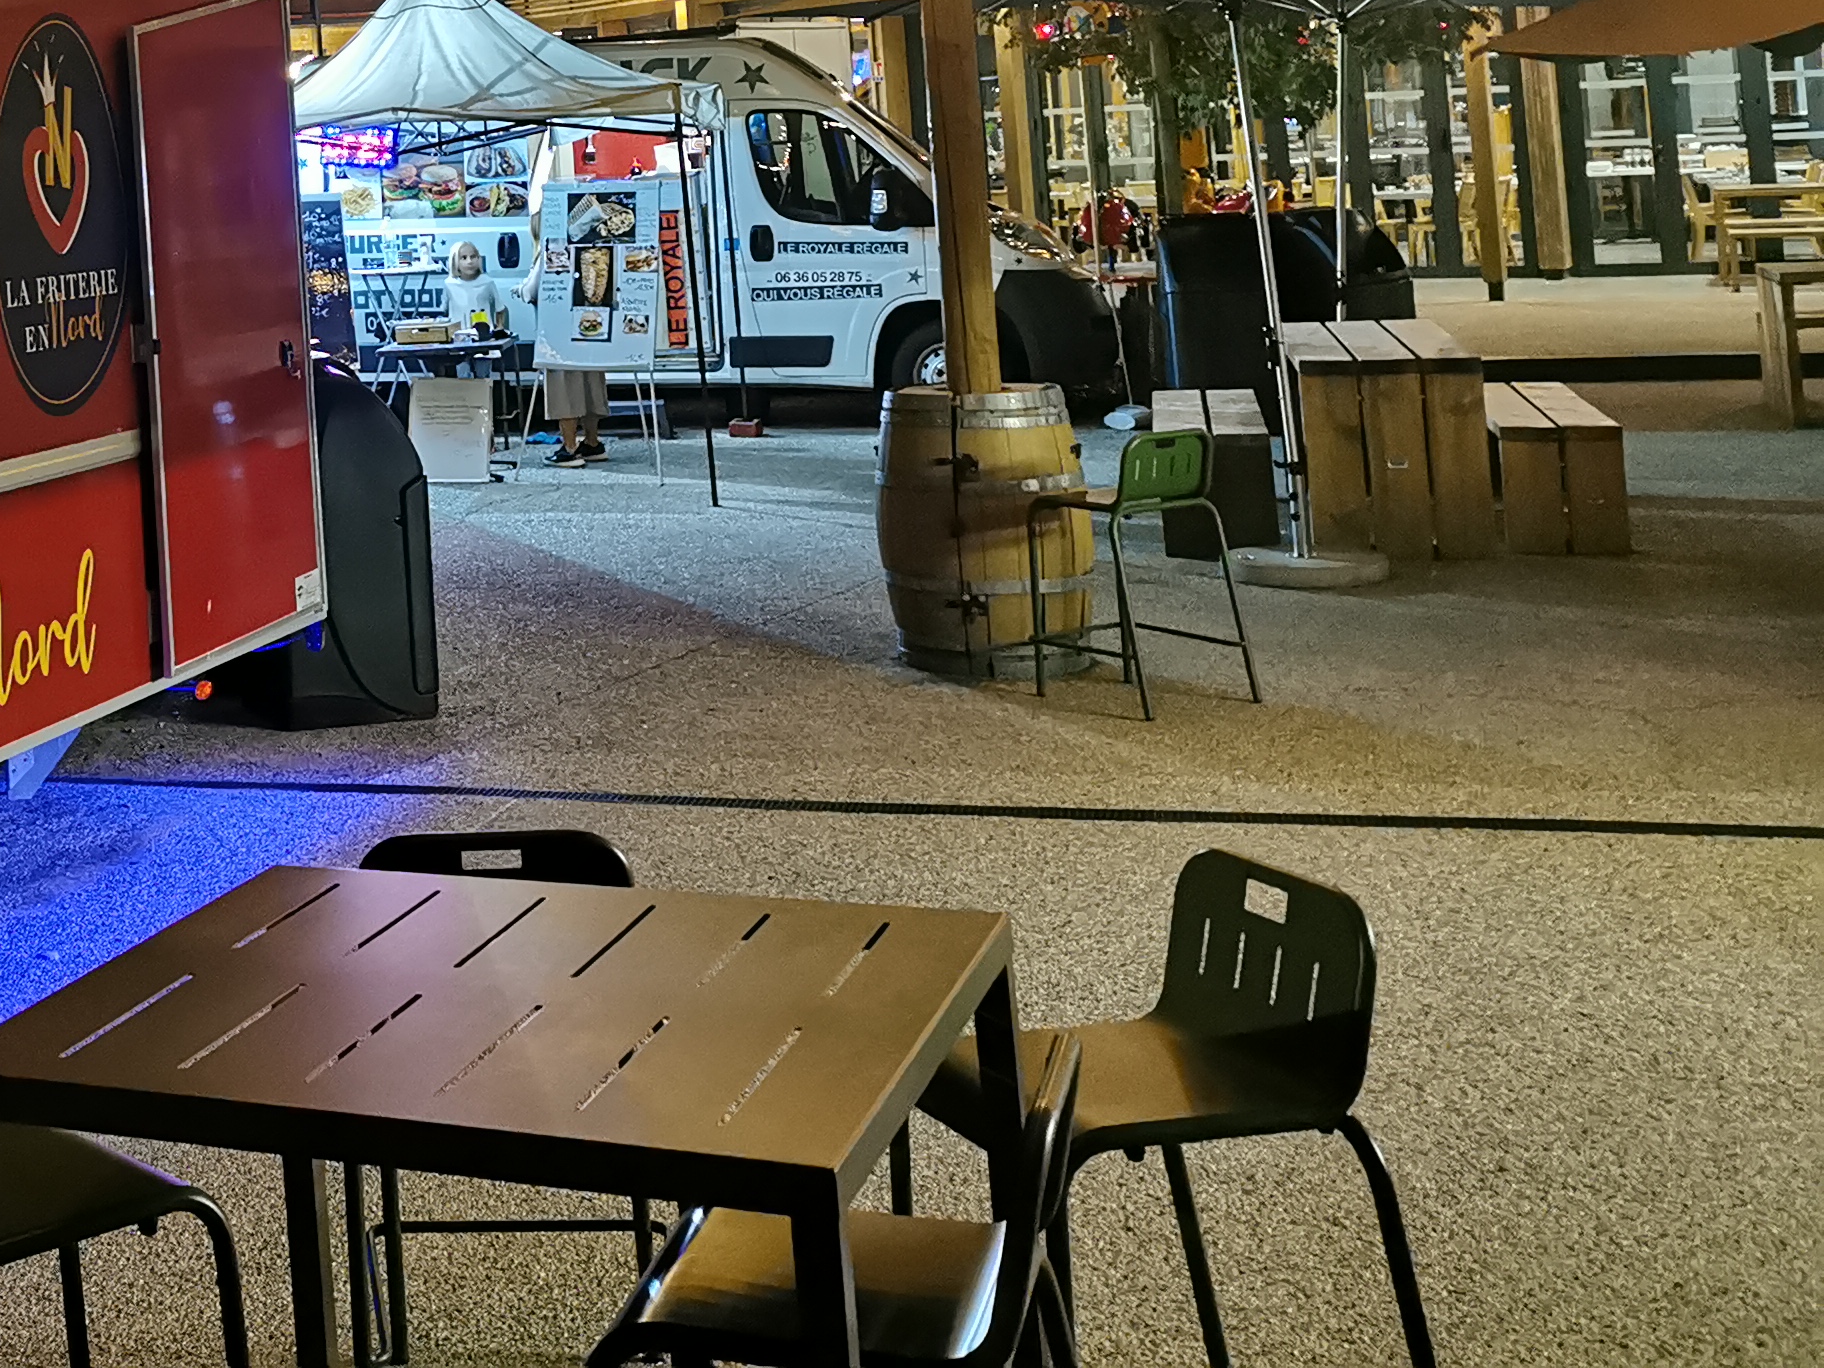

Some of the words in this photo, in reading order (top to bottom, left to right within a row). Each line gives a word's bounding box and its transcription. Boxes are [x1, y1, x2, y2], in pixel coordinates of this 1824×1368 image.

[660, 213, 687, 311] ROYALE
[780, 243, 795, 254] LE
[798, 243, 851, 254] ROYALE
[854, 241, 906, 254] RÉGALE
[5, 278, 31, 308] LA
[36, 269, 118, 304] FRITERIE
[775, 272, 791, 283] 06
[793, 272, 809, 283] 36
[811, 272, 827, 283] 05
[829, 272, 845, 283] 28
[847, 271, 862, 282] 75
[752, 289, 777, 301] QUI
[780, 288, 820, 300] VOUS
[823, 285, 880, 299] RÉGALE
[24, 324, 50, 353] EN
[45, 288, 105, 349] Nord
[667, 317, 689, 348] LE
